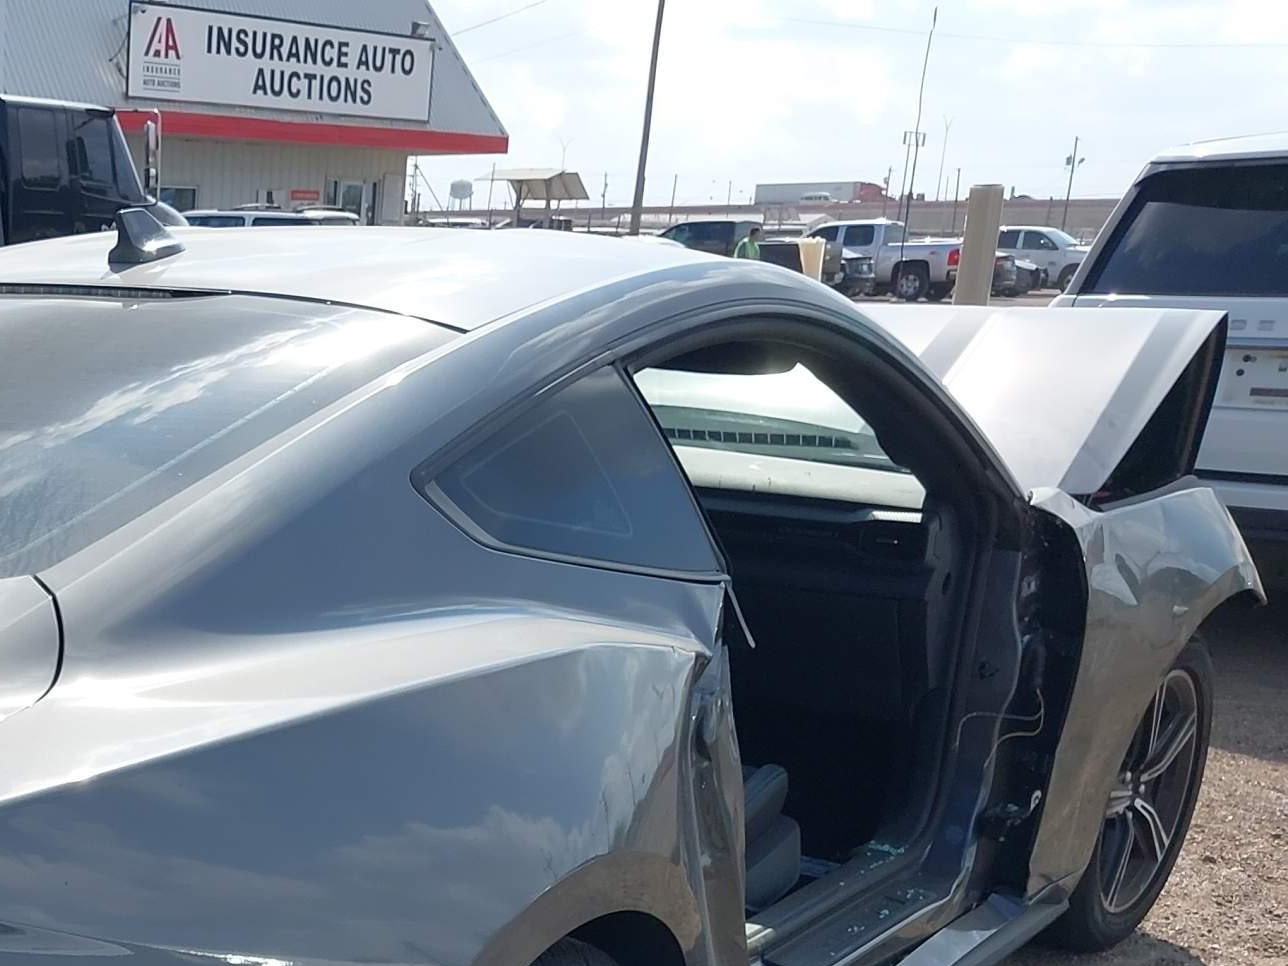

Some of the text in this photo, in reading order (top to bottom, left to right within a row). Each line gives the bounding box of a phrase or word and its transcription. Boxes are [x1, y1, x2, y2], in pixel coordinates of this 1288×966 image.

[206, 24, 415, 76] INSURANCE AUTO
[252, 68, 373, 106] AUCTIONS
